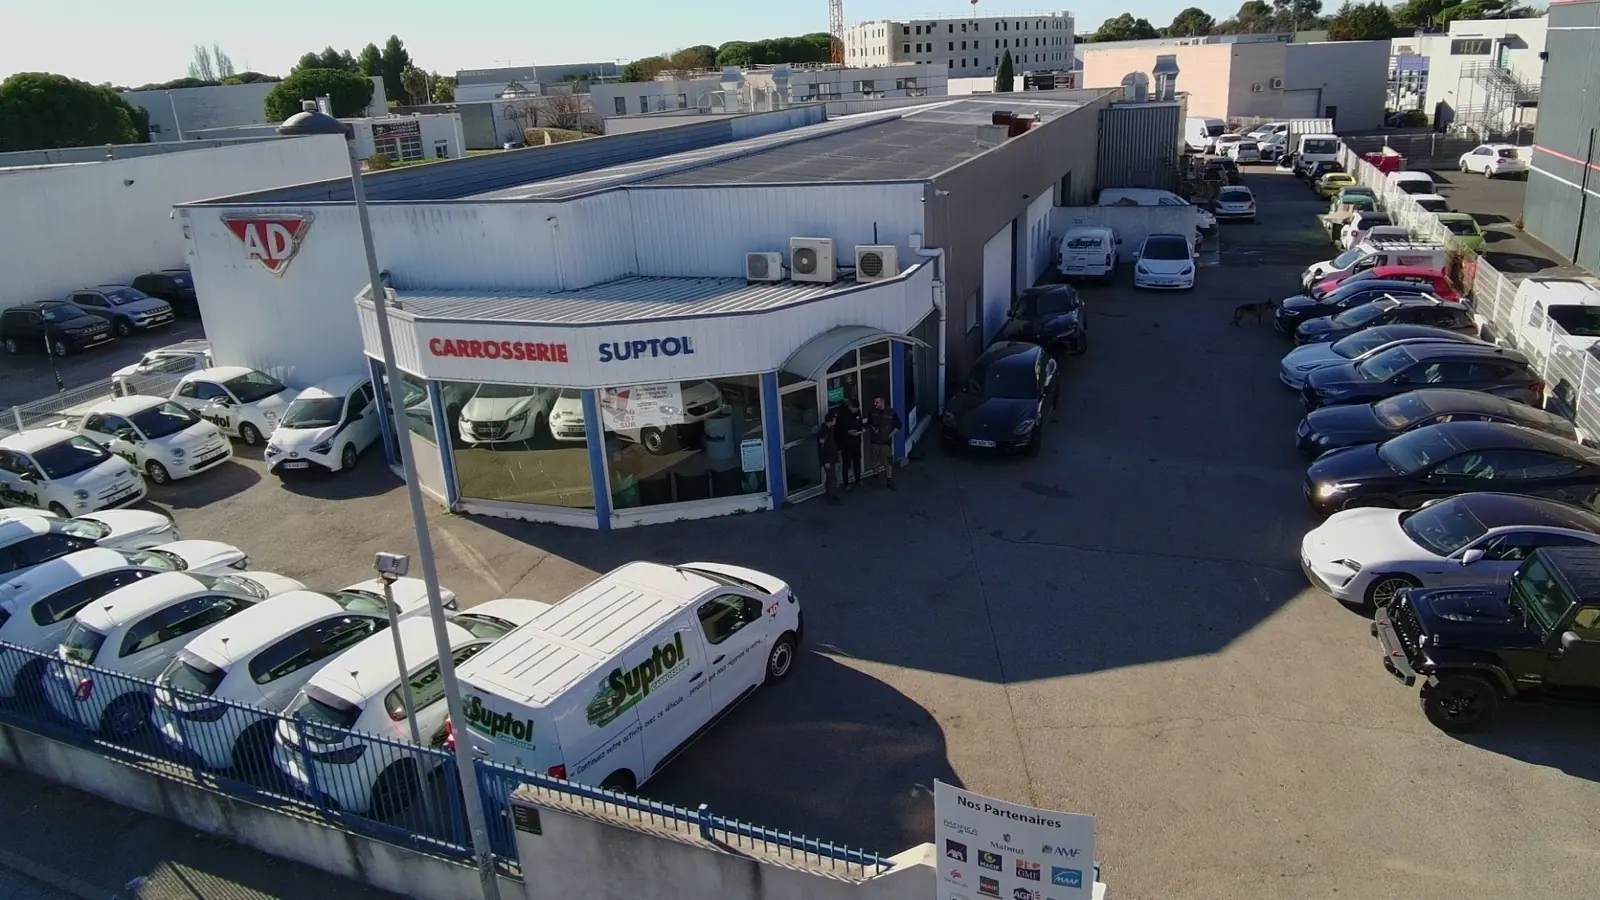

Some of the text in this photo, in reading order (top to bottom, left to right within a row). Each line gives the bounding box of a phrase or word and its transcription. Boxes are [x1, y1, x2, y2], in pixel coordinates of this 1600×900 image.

[244, 222, 293, 260] AD
[429, 337, 569, 363] CARROSSERIE
[599, 336, 694, 363] SUPTOL
[608, 631, 685, 708] Suptol
[469, 695, 534, 742] Suptol
[957, 795, 1062, 829] Nos Partenaires
[990, 840, 1024, 855] Matmut
[1053, 846, 1081, 858] AMF
[980, 861, 1000, 870] MACIF
[1017, 868, 1040, 880] GMF
